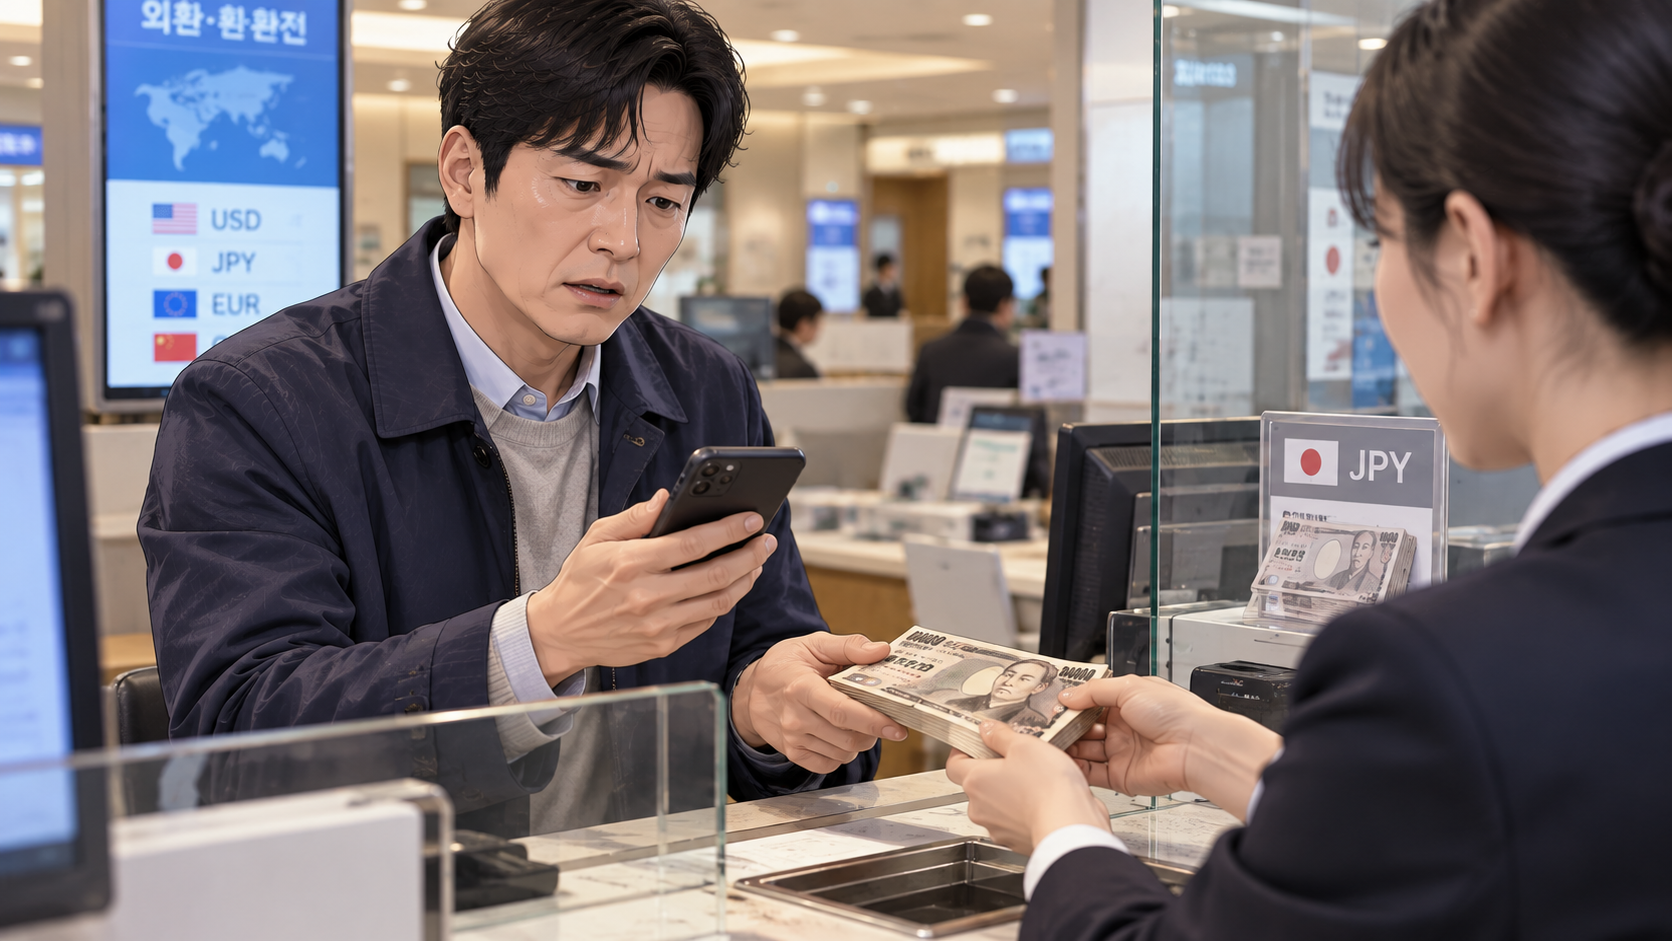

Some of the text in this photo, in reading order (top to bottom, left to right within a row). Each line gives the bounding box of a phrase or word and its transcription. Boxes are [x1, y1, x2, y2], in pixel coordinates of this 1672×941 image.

[211, 208, 262, 232] USD
[211, 251, 256, 274] JPY
[211, 293, 261, 316] EUR
[1349, 449, 1413, 484] JPY
